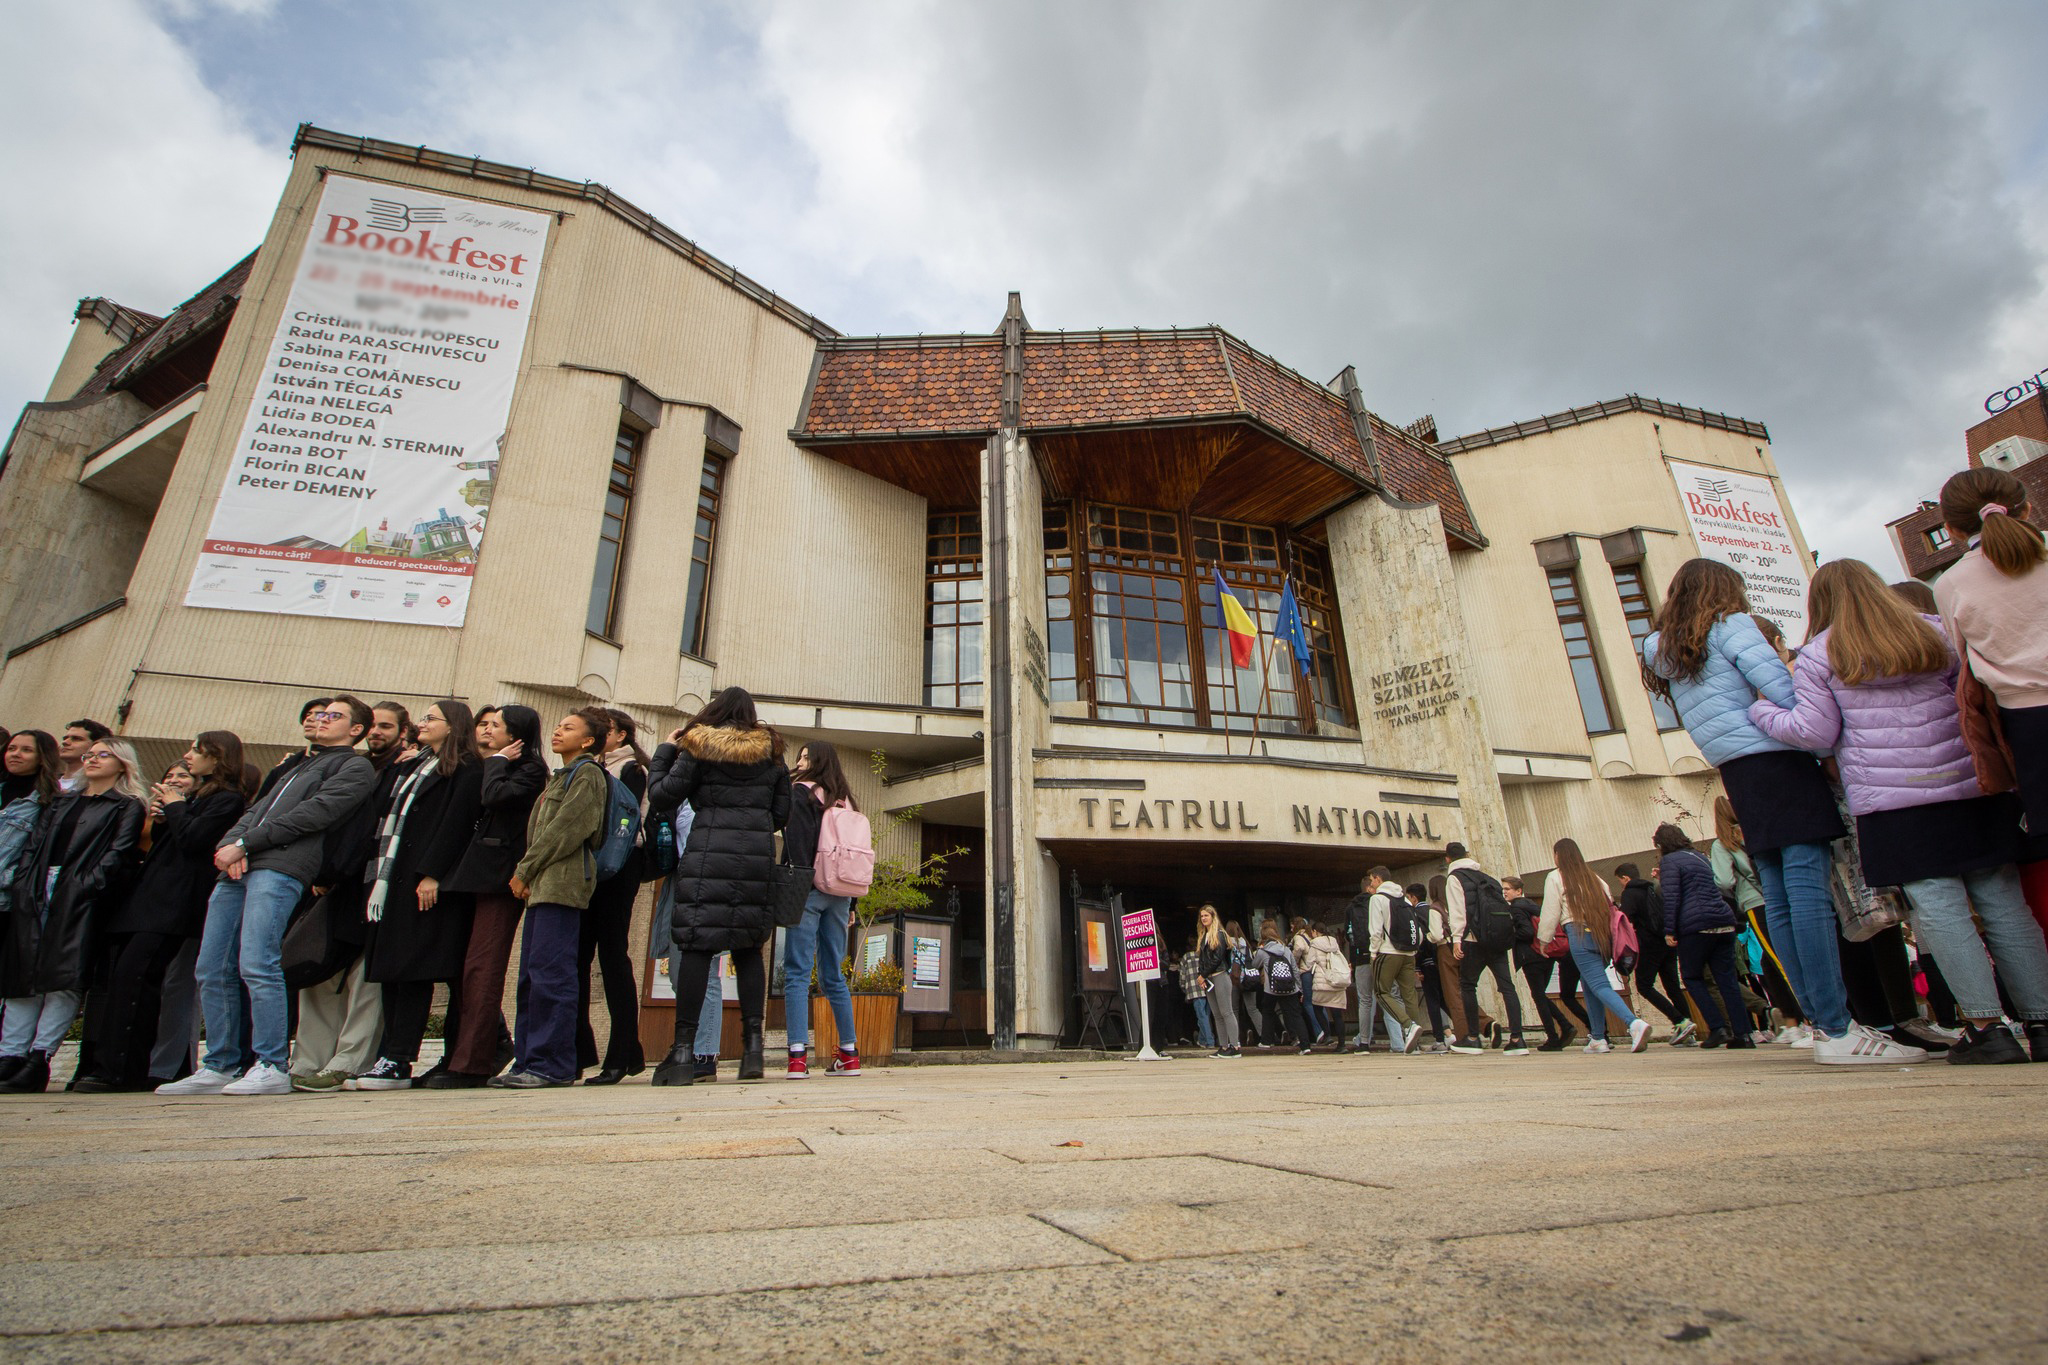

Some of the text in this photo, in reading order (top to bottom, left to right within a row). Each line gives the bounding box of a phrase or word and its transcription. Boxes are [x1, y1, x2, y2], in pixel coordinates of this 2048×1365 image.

[320, 213, 528, 275] Bookfest
[439, 267, 523, 288] ediția a VII-a
[390, 279, 519, 310] septembrie
[294, 311, 500, 350] Cristian Tudor POPESCU
[284, 341, 387, 365] Sabina FATI
[288, 326, 487, 363] Radu PARASCHIVESCU
[272, 373, 403, 399] István TÉGLÁS
[278, 357, 461, 391] Denisa COMĂNESCU
[1984, 367, 2048, 413] CON
[267, 390, 394, 415] Alina NELEGA
[261, 406, 376, 430] Lidia BODEA
[250, 439, 348, 461] Ioana BOT
[255, 423, 464, 457] Alexandru N. STERMIN
[244, 457, 366, 481] Florin BICAN
[238, 475, 377, 500] Peter DEMENY
[1684, 491, 1781, 528] Bookfest
[1693, 516, 1786, 539] Könyvkiállítás, VII. kiadás
[213, 543, 312, 561] Cele mai bune cărți!
[1699, 531, 1759, 550] Szeptember
[1761, 540, 1773, 551] 22
[1780, 544, 1792, 554] 25
[354, 556, 467, 573] Reduceri spectaculoase!
[1742, 571, 1800, 586] Tudor POPESCU
[1747, 583, 1800, 597] RASCHIVESCU
[1747, 594, 1765, 603] FATI
[1371, 655, 1451, 690] NEMZETI
[1374, 704, 1410, 720] TOMPA
[1079, 798, 1441, 841] TEATRUL NATIONAL
[1124, 921, 1154, 937] DESCHISĂ
[1130, 958, 1153, 971] NYITVA
